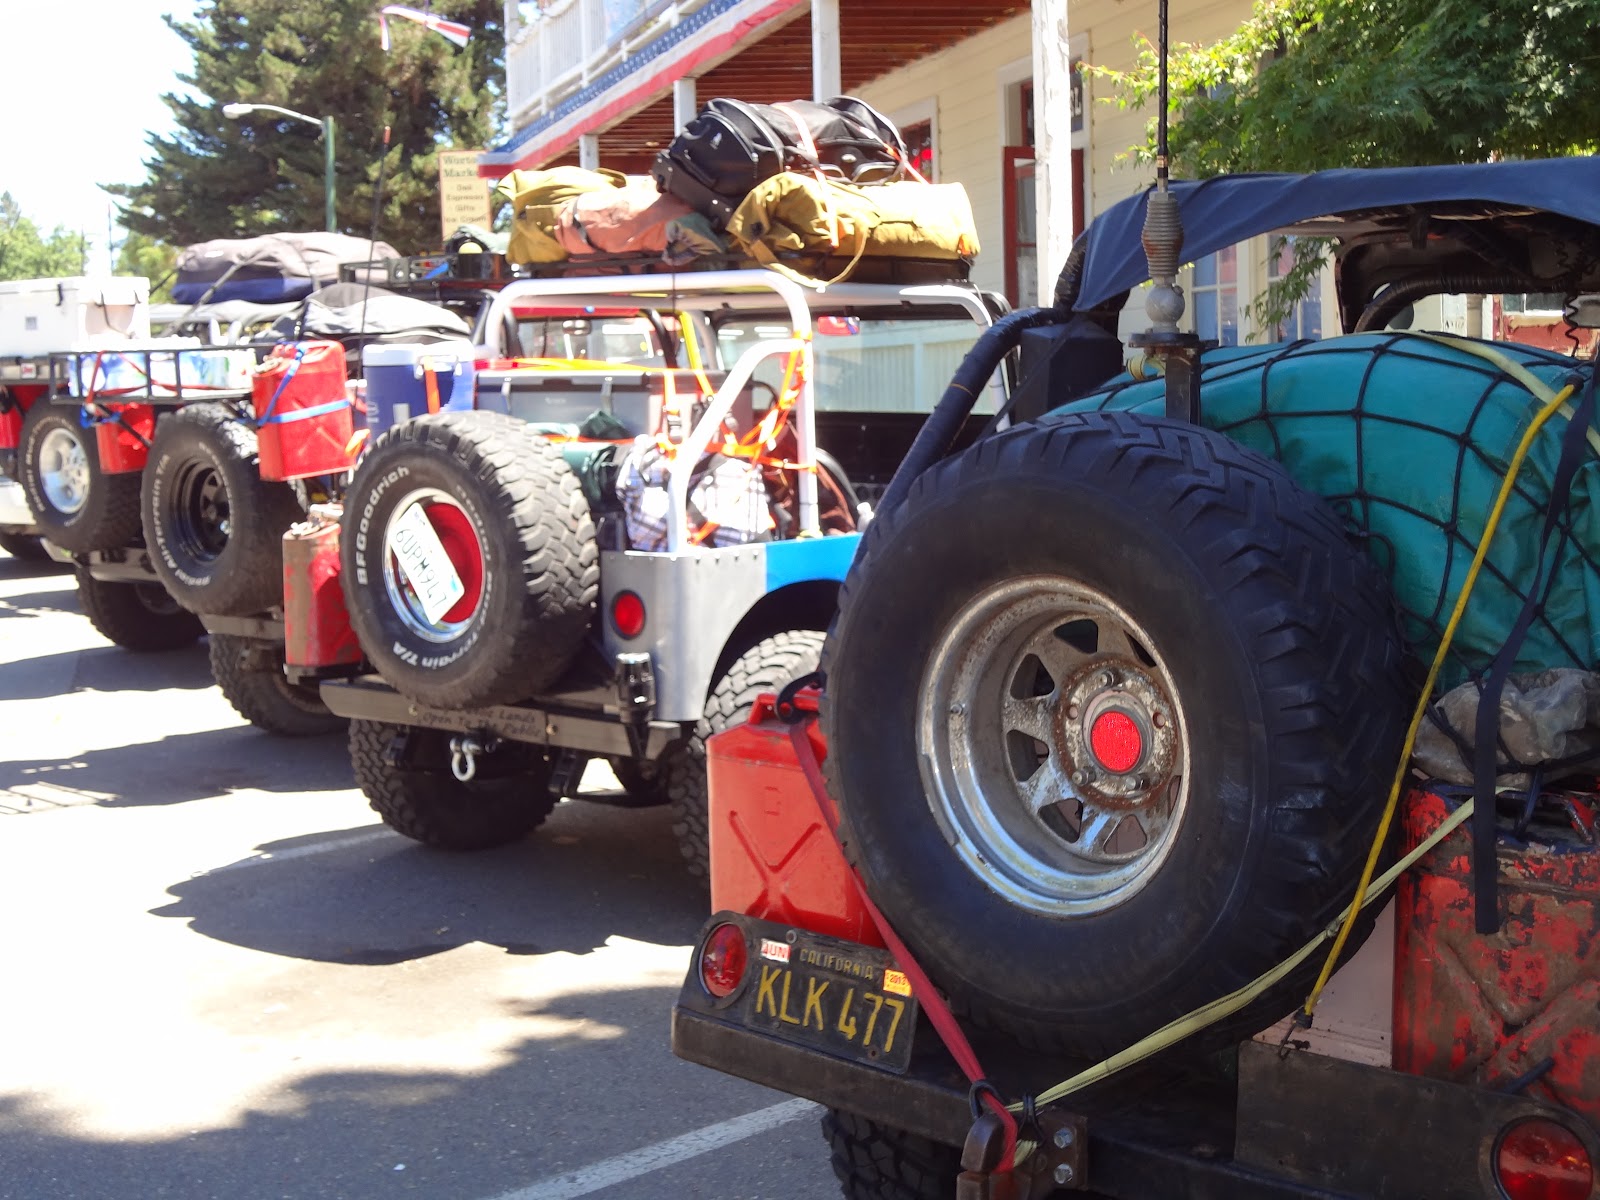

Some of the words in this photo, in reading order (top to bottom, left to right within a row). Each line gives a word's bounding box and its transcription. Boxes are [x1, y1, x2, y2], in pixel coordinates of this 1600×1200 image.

[800, 949, 874, 979] CALIFORNIA
[756, 964, 830, 1031] KLK
[838, 988, 906, 1052] 477
